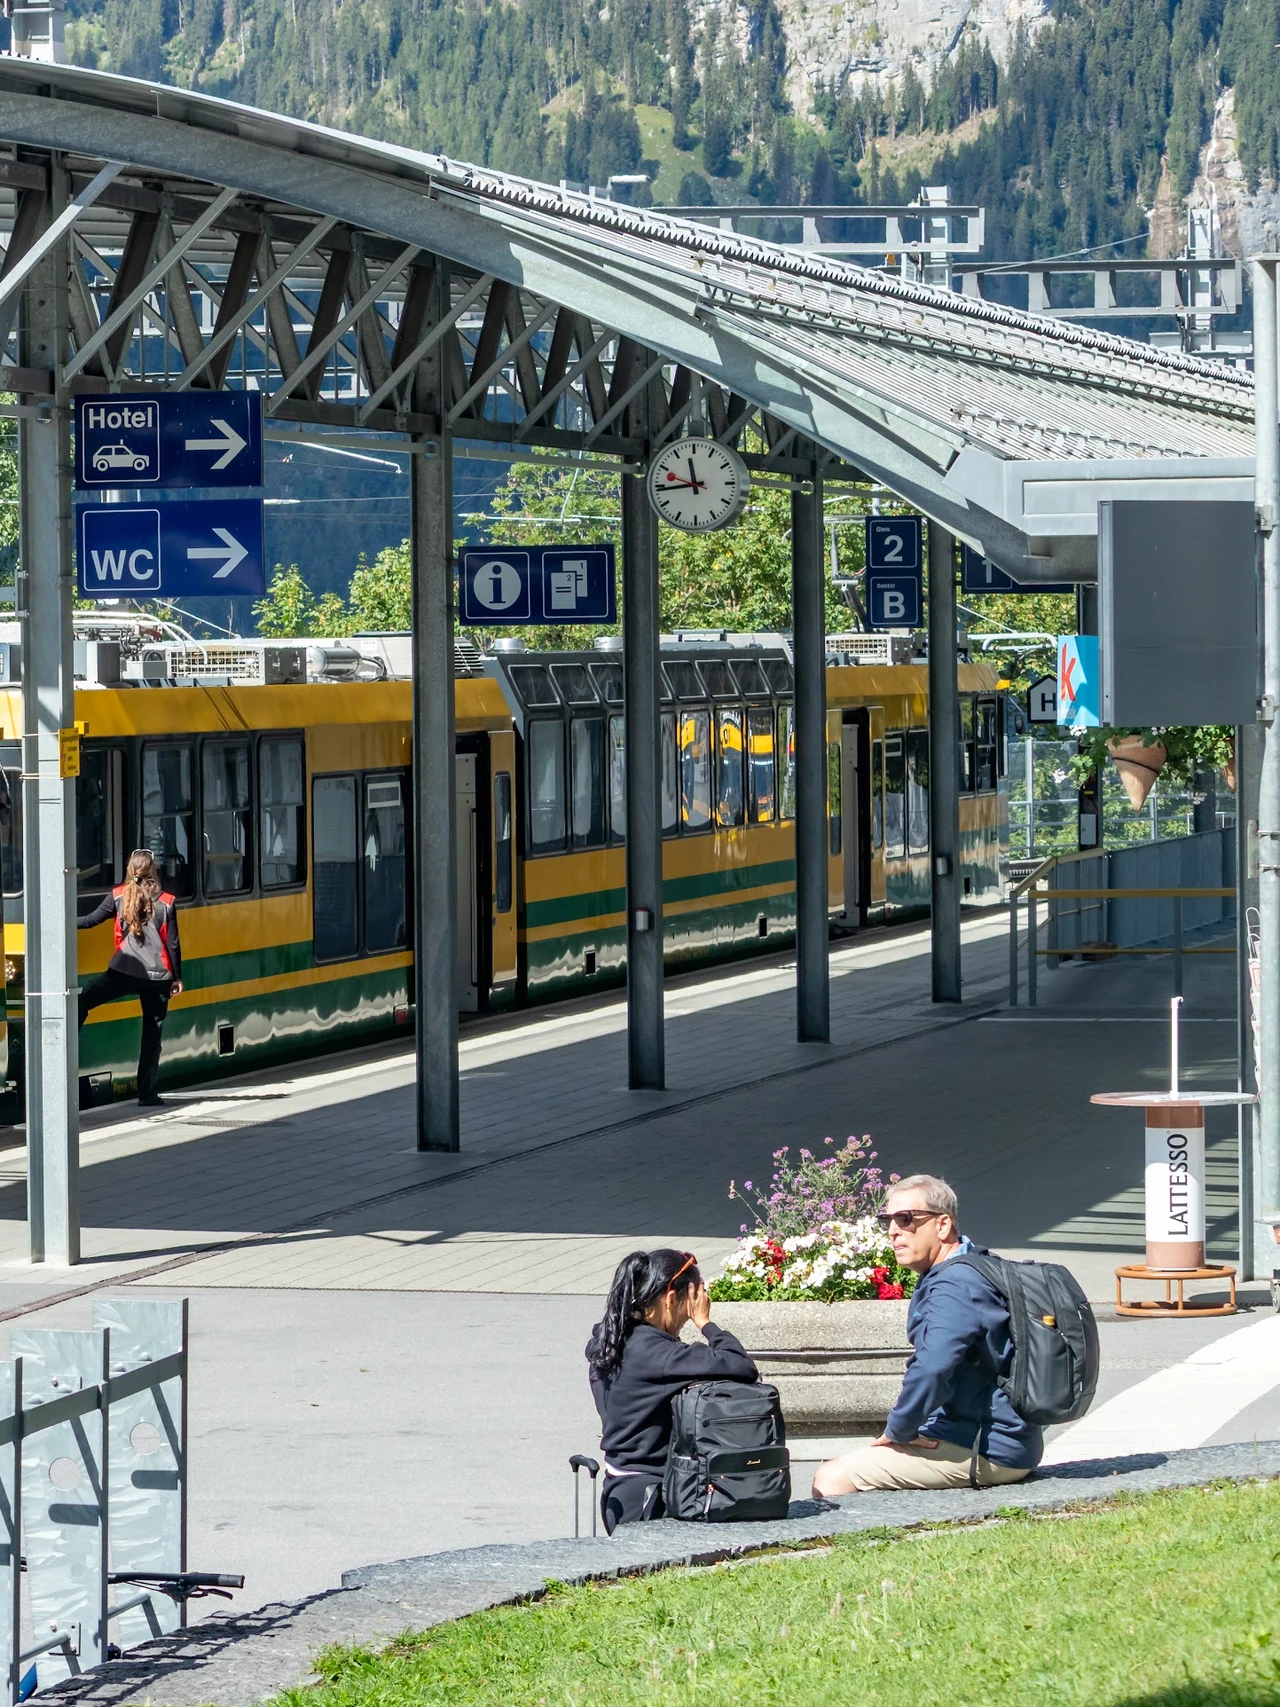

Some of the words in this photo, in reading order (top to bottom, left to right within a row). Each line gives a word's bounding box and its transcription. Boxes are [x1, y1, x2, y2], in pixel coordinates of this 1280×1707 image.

[88, 406, 153, 429] Hotel
[883, 535, 904, 562] 2
[90, 548, 154, 581] WC
[981, 559, 993, 584] 1
[883, 591, 906, 619] B
[1040, 692, 1057, 712] H
[1166, 1133, 1189, 1236] LATTESSO
